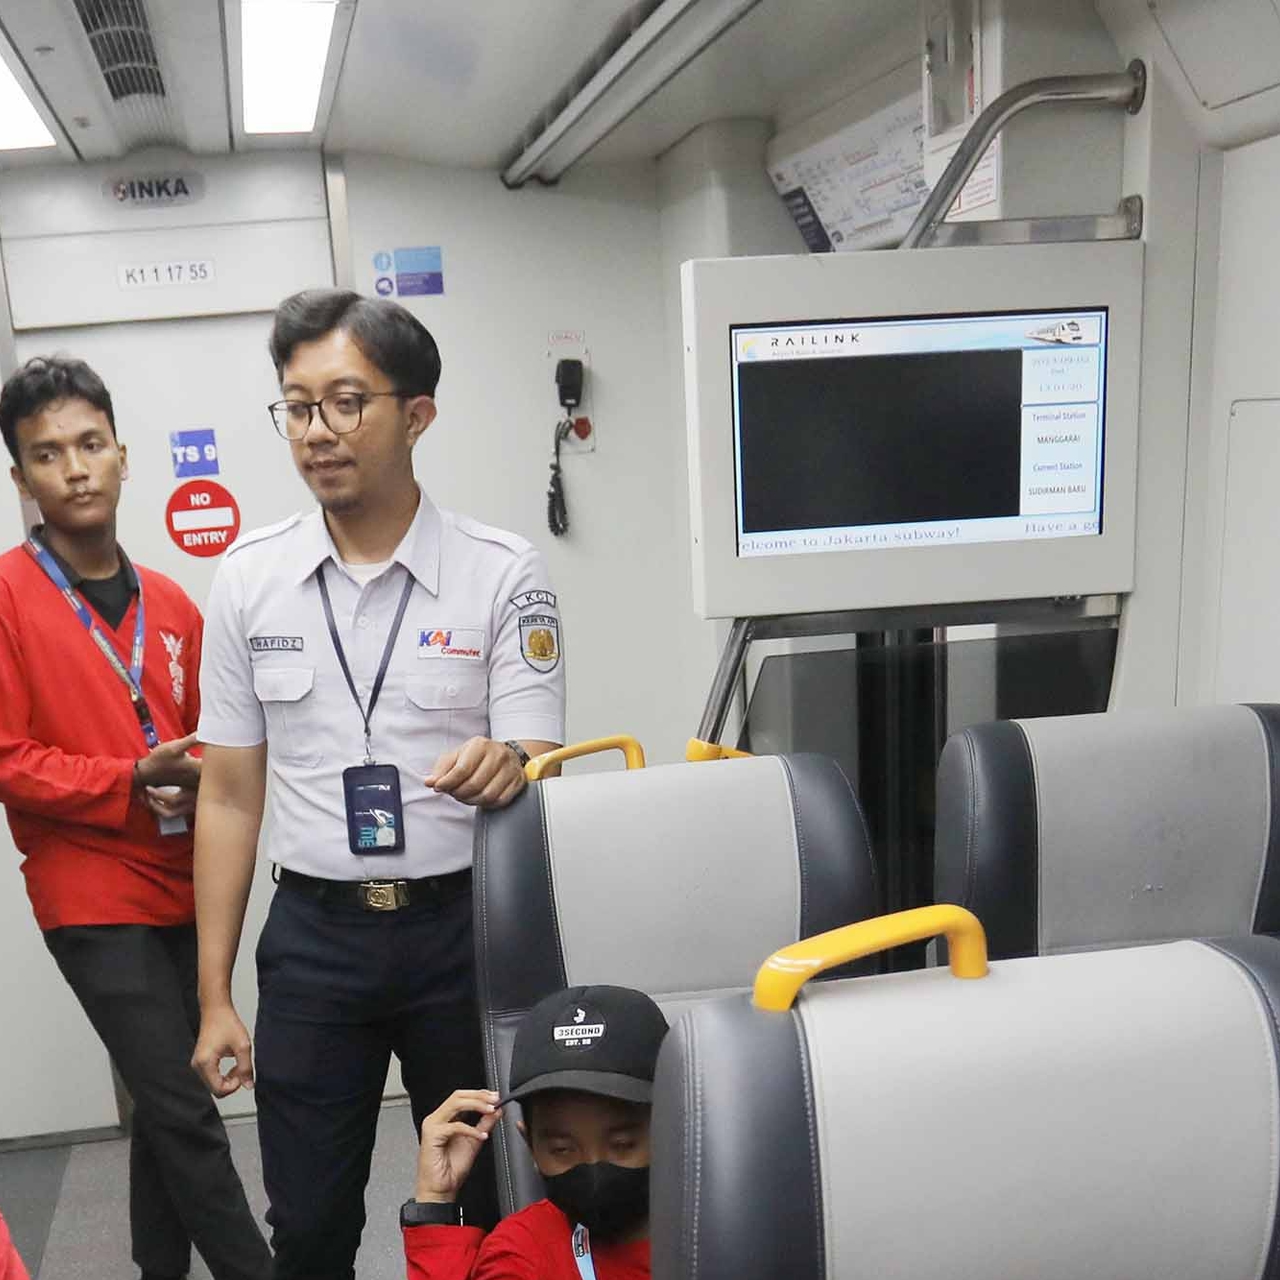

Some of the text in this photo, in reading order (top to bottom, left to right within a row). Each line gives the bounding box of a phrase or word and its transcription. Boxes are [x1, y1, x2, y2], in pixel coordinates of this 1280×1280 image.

[128, 178, 189, 199] INKA
[125, 268, 146, 284] K1
[167, 264, 183, 281] 17
[189, 263, 208, 281] 55
[771, 334, 860, 347] RAILINK
[1033, 411, 1087, 422] Terminal Station
[1037, 435, 1081, 445] MANGGARAI
[173, 443, 217, 463] TS 9
[1033, 461, 1083, 473] Current Station
[1028, 484, 1086, 497] SUDIRMAN BARU
[189, 492, 211, 506] NO
[1024, 521, 1064, 534] Have
[183, 530, 227, 547] ENTRY
[802, 535, 821, 547] to
[823, 531, 889, 547] Jakarta
[894, 526, 961, 543] subway!
[524, 591, 549, 603] KCI
[418, 629, 452, 647] KAI
[440, 647, 481, 657] Commuter
[556, 1027, 600, 1037] 3SECOND
